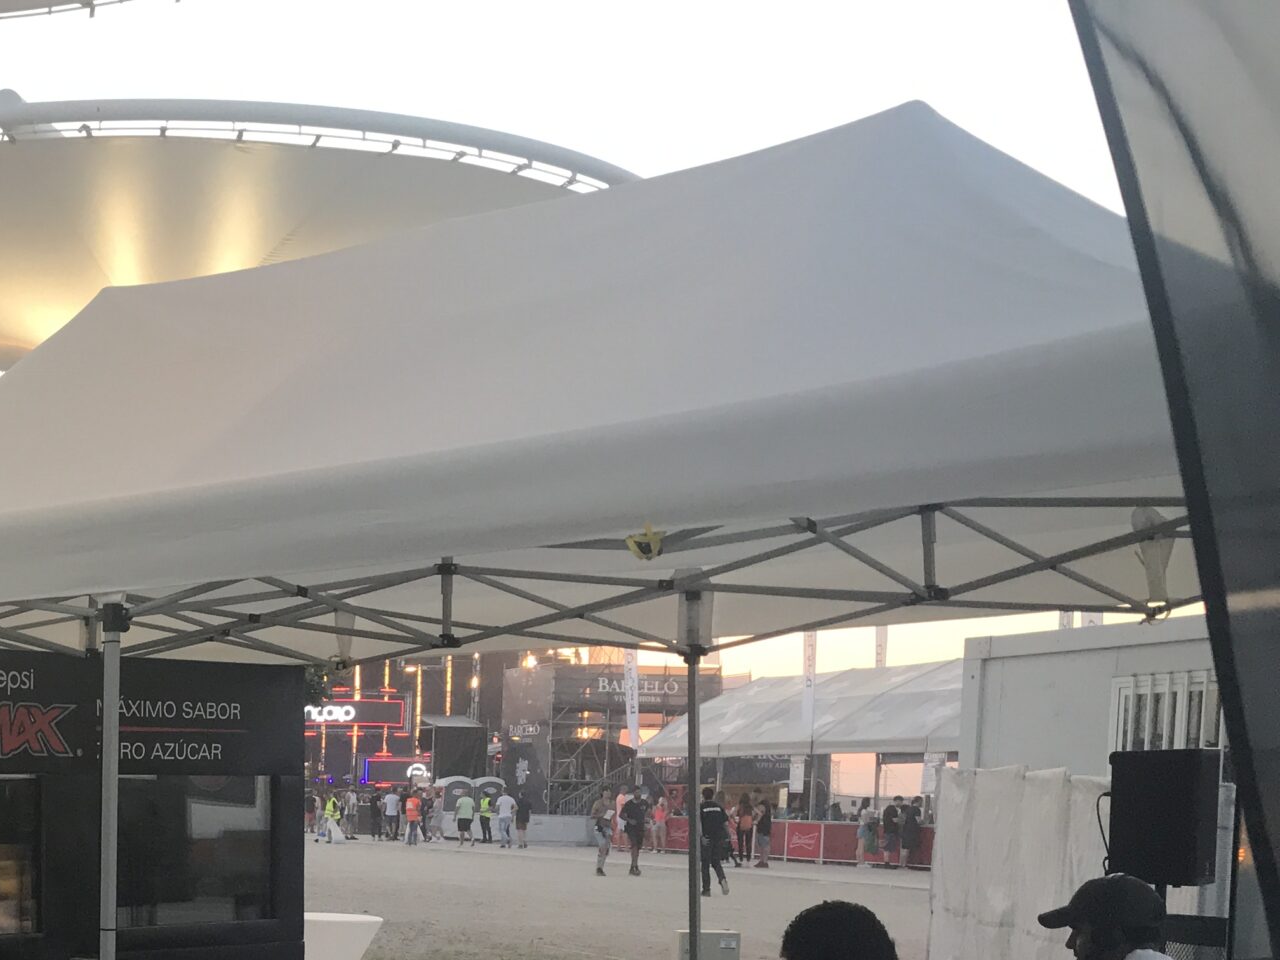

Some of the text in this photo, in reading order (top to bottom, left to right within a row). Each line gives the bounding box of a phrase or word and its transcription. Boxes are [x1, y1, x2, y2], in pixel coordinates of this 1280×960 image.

[598, 677, 679, 694] BAELÓ
[182, 701, 241, 720] SABOR
[151, 739, 222, 760] AZÚCAR
